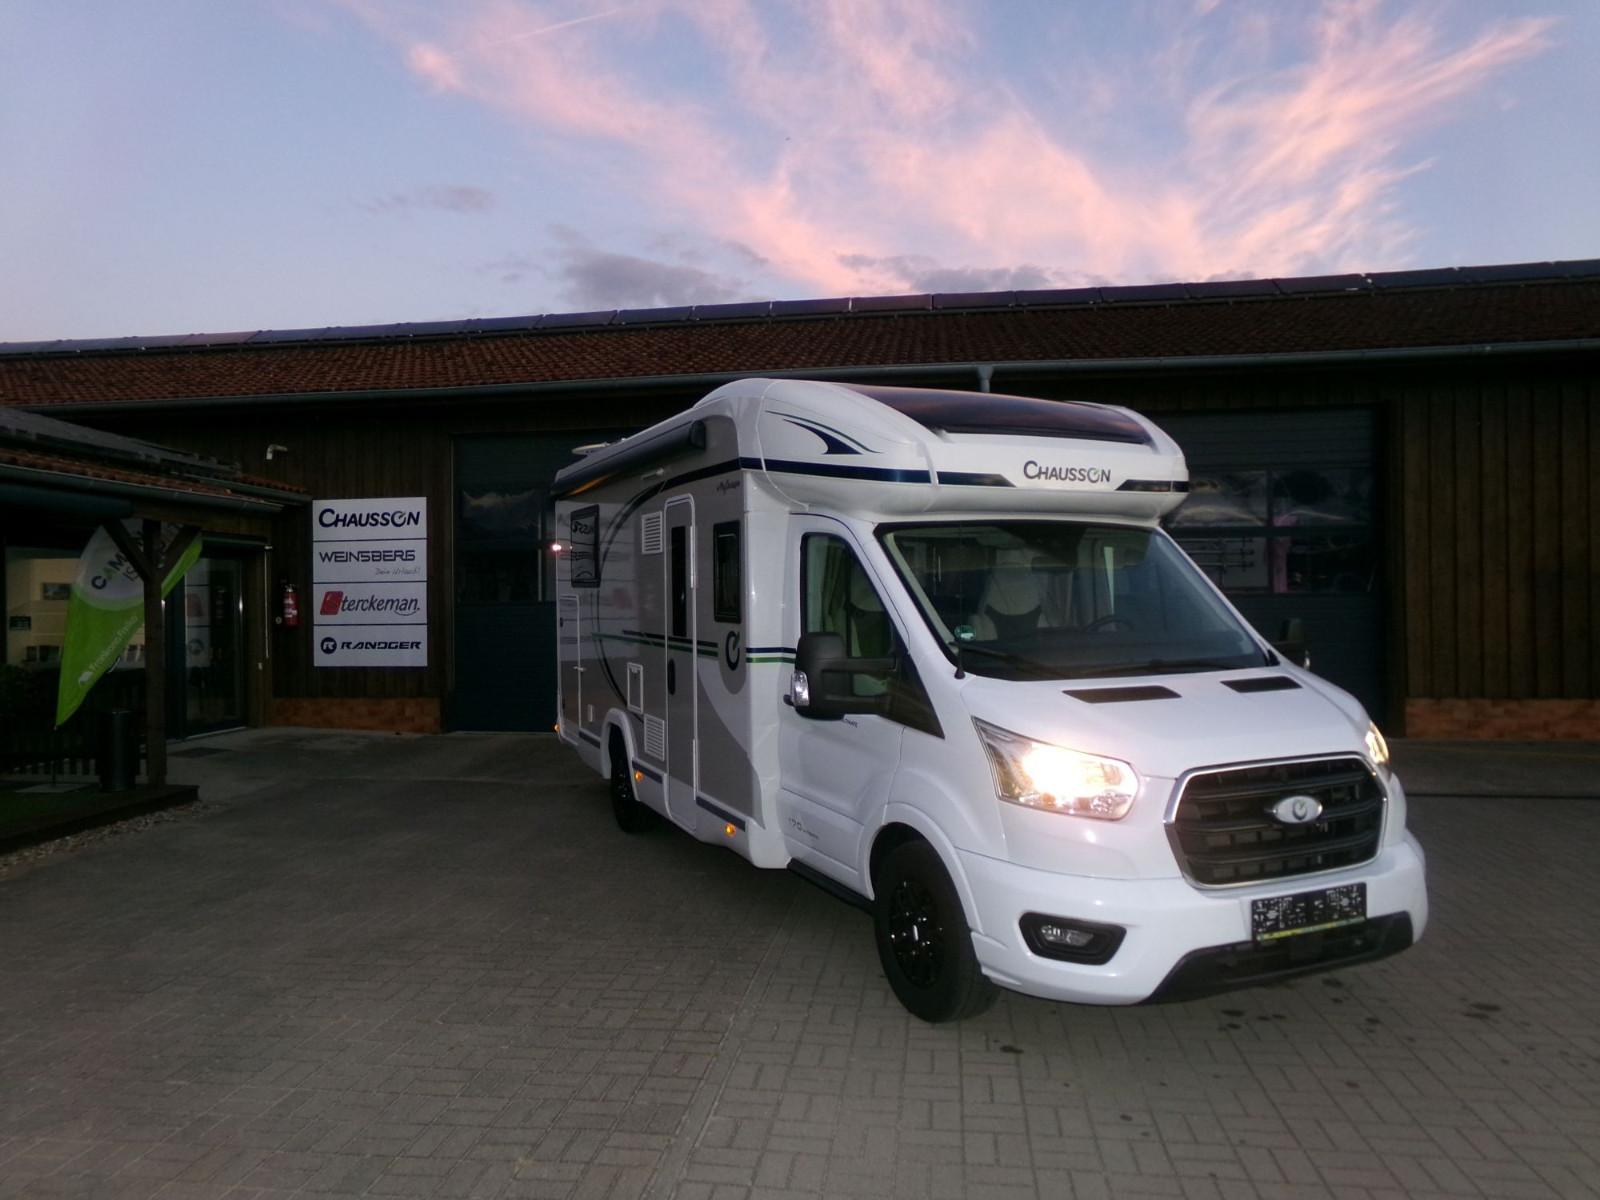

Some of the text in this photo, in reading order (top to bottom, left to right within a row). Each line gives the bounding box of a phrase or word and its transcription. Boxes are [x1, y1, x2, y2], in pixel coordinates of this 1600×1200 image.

[1023, 460, 1111, 484] CHAUSSON
[318, 508, 420, 528] CHAUSSON
[319, 550, 416, 563] WEINSBERG
